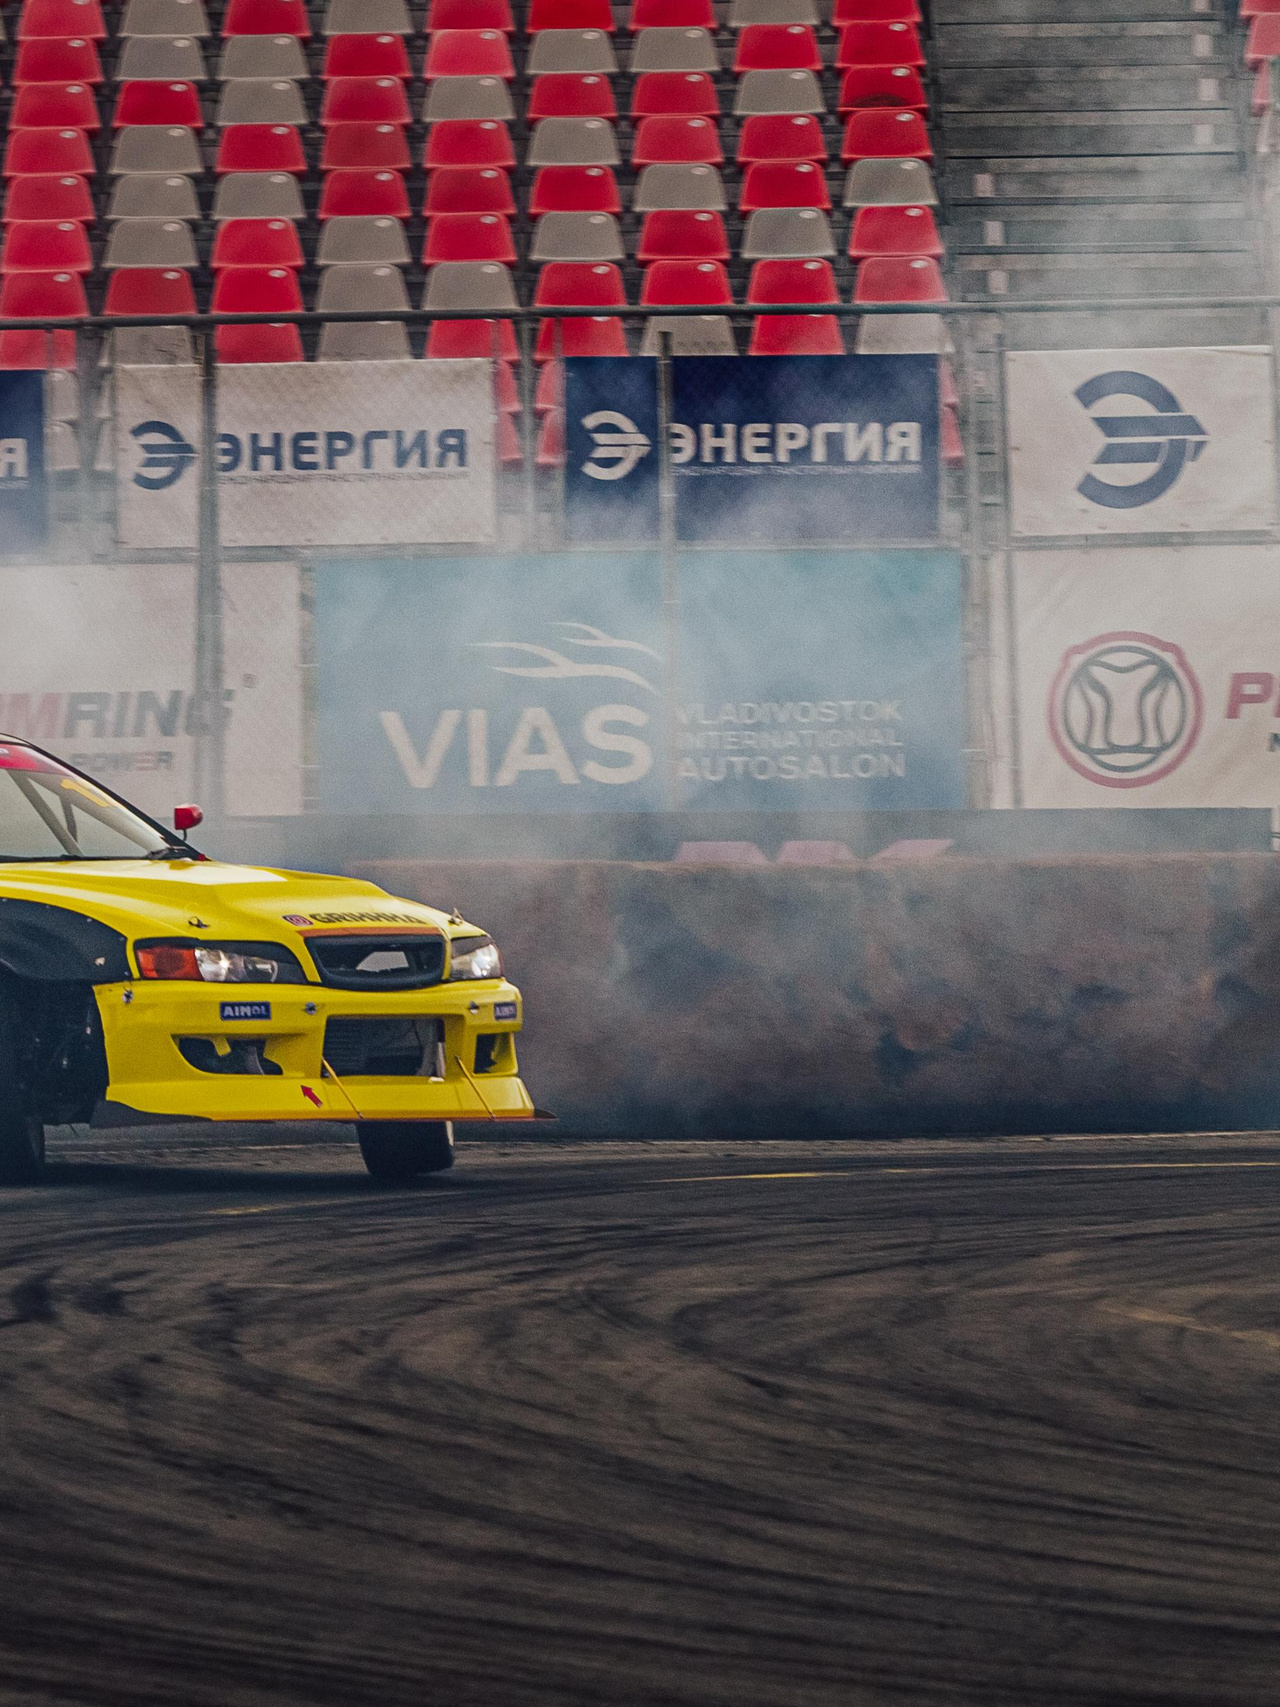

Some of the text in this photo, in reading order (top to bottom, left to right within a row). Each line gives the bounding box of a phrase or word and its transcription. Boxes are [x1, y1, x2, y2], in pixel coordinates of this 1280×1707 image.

[216, 428, 467, 472] ЭНЕРГИЯ
[668, 421, 922, 463] ЭНЕРГИЯ
[380, 703, 654, 788] VIAS
[675, 753, 907, 781] AUTOSALON
